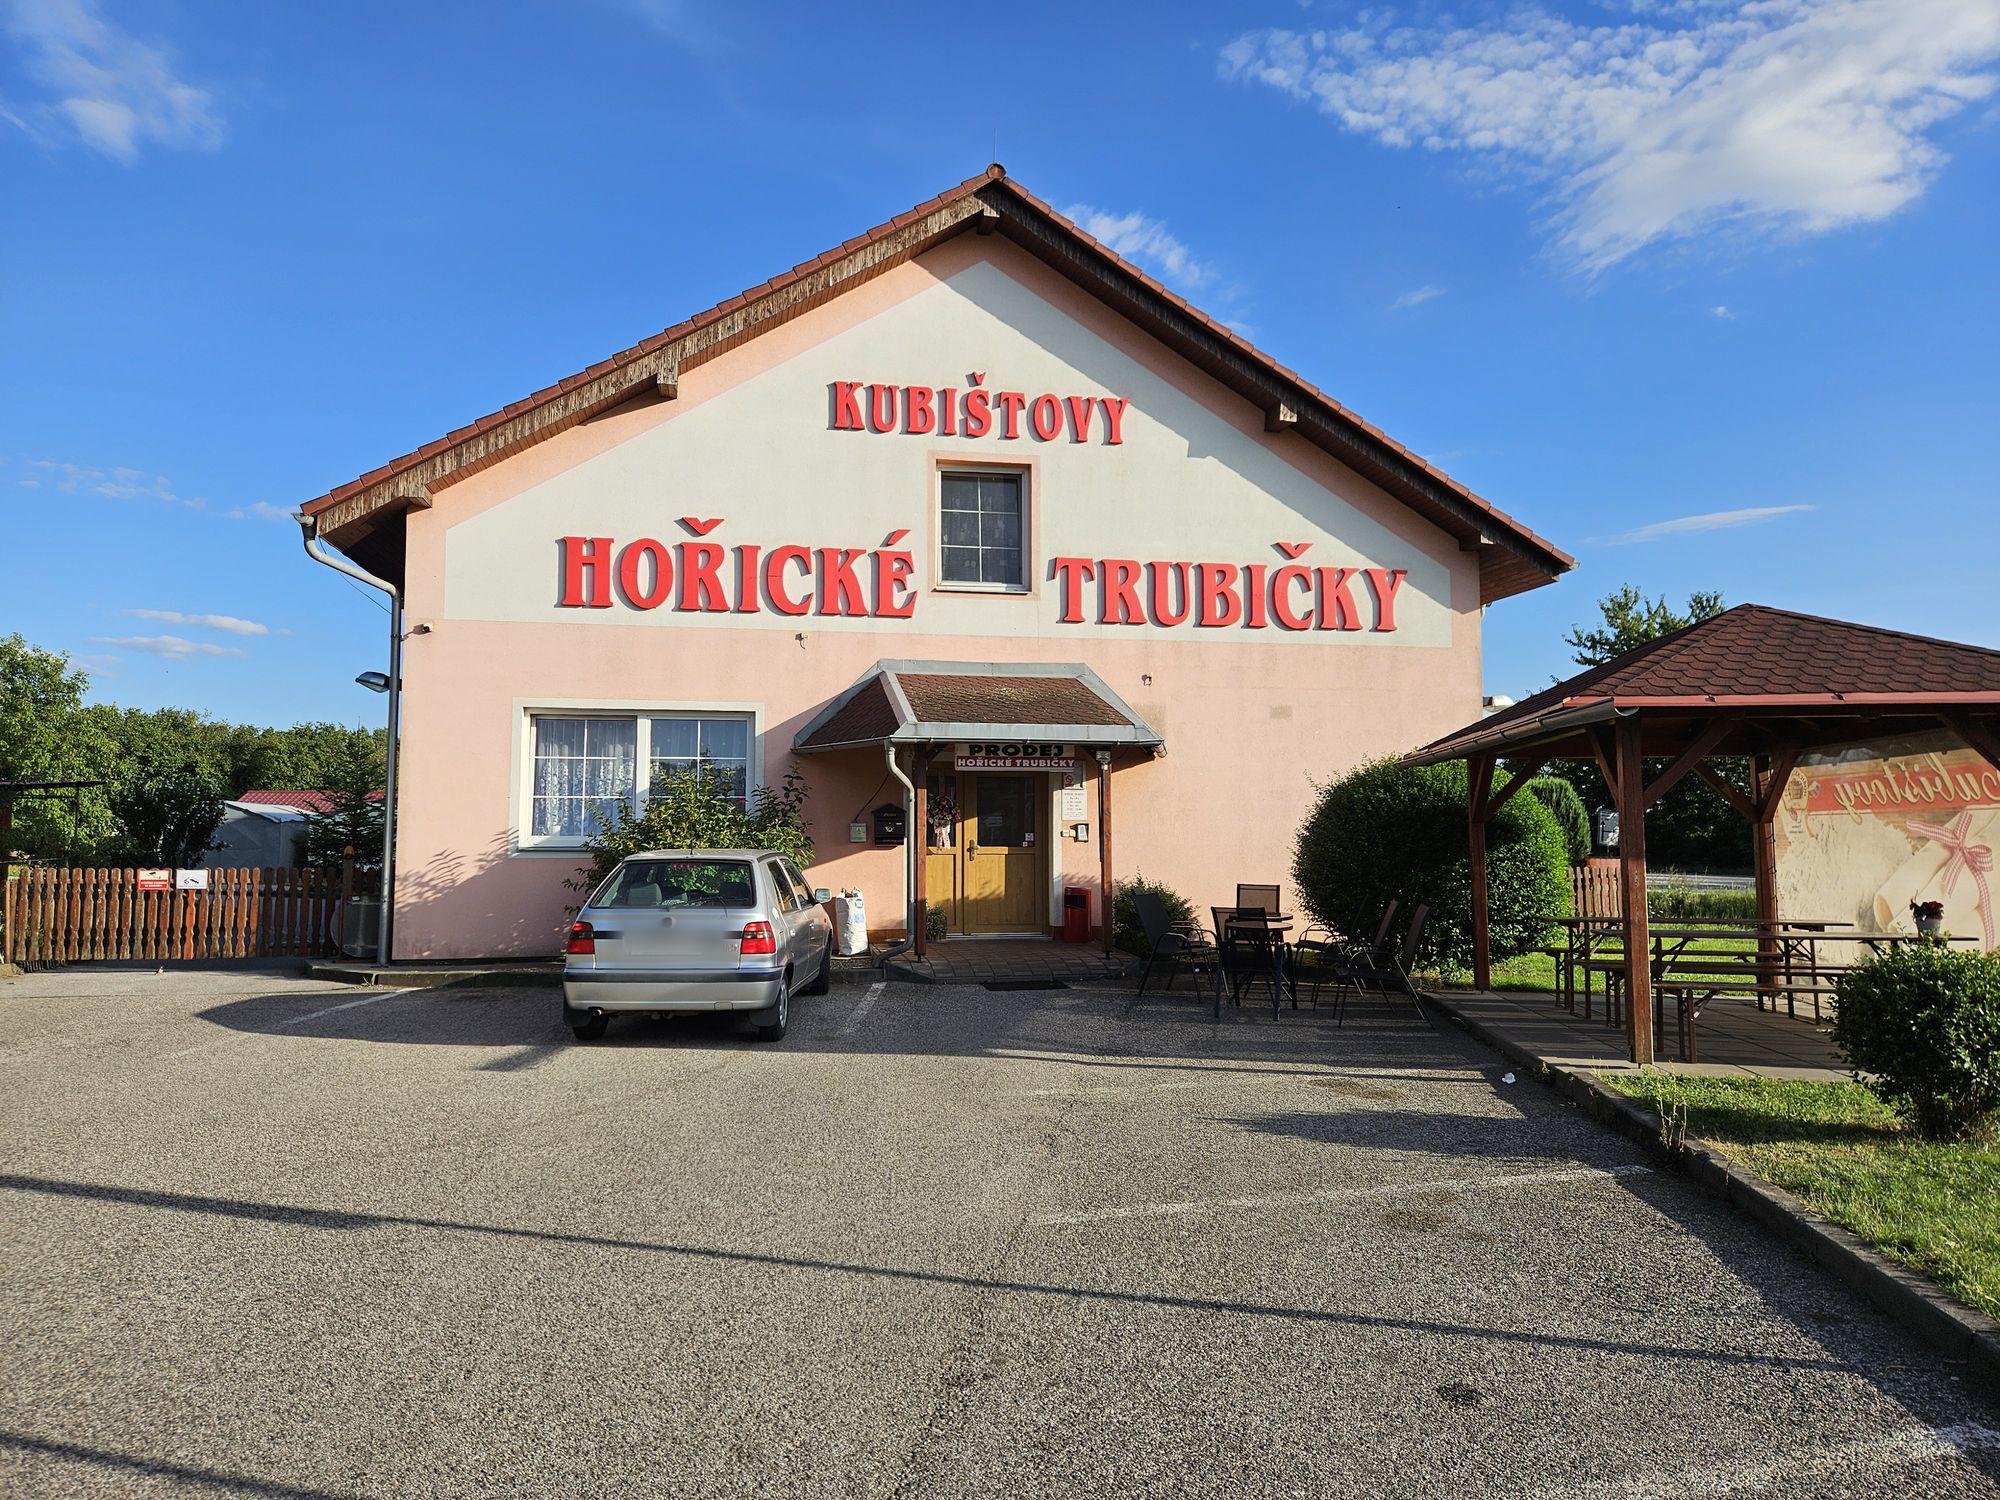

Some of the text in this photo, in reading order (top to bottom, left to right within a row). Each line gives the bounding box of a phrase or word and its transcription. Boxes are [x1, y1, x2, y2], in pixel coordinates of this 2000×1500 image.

[832, 371, 1129, 445] KUBIŠTOVY
[559, 516, 1408, 632] HOŘICKÉ TRUBIČKY
[957, 757, 1075, 767] HOŘICKÉ TRUBIČKY
[969, 744, 1064, 757] PRODEJ
